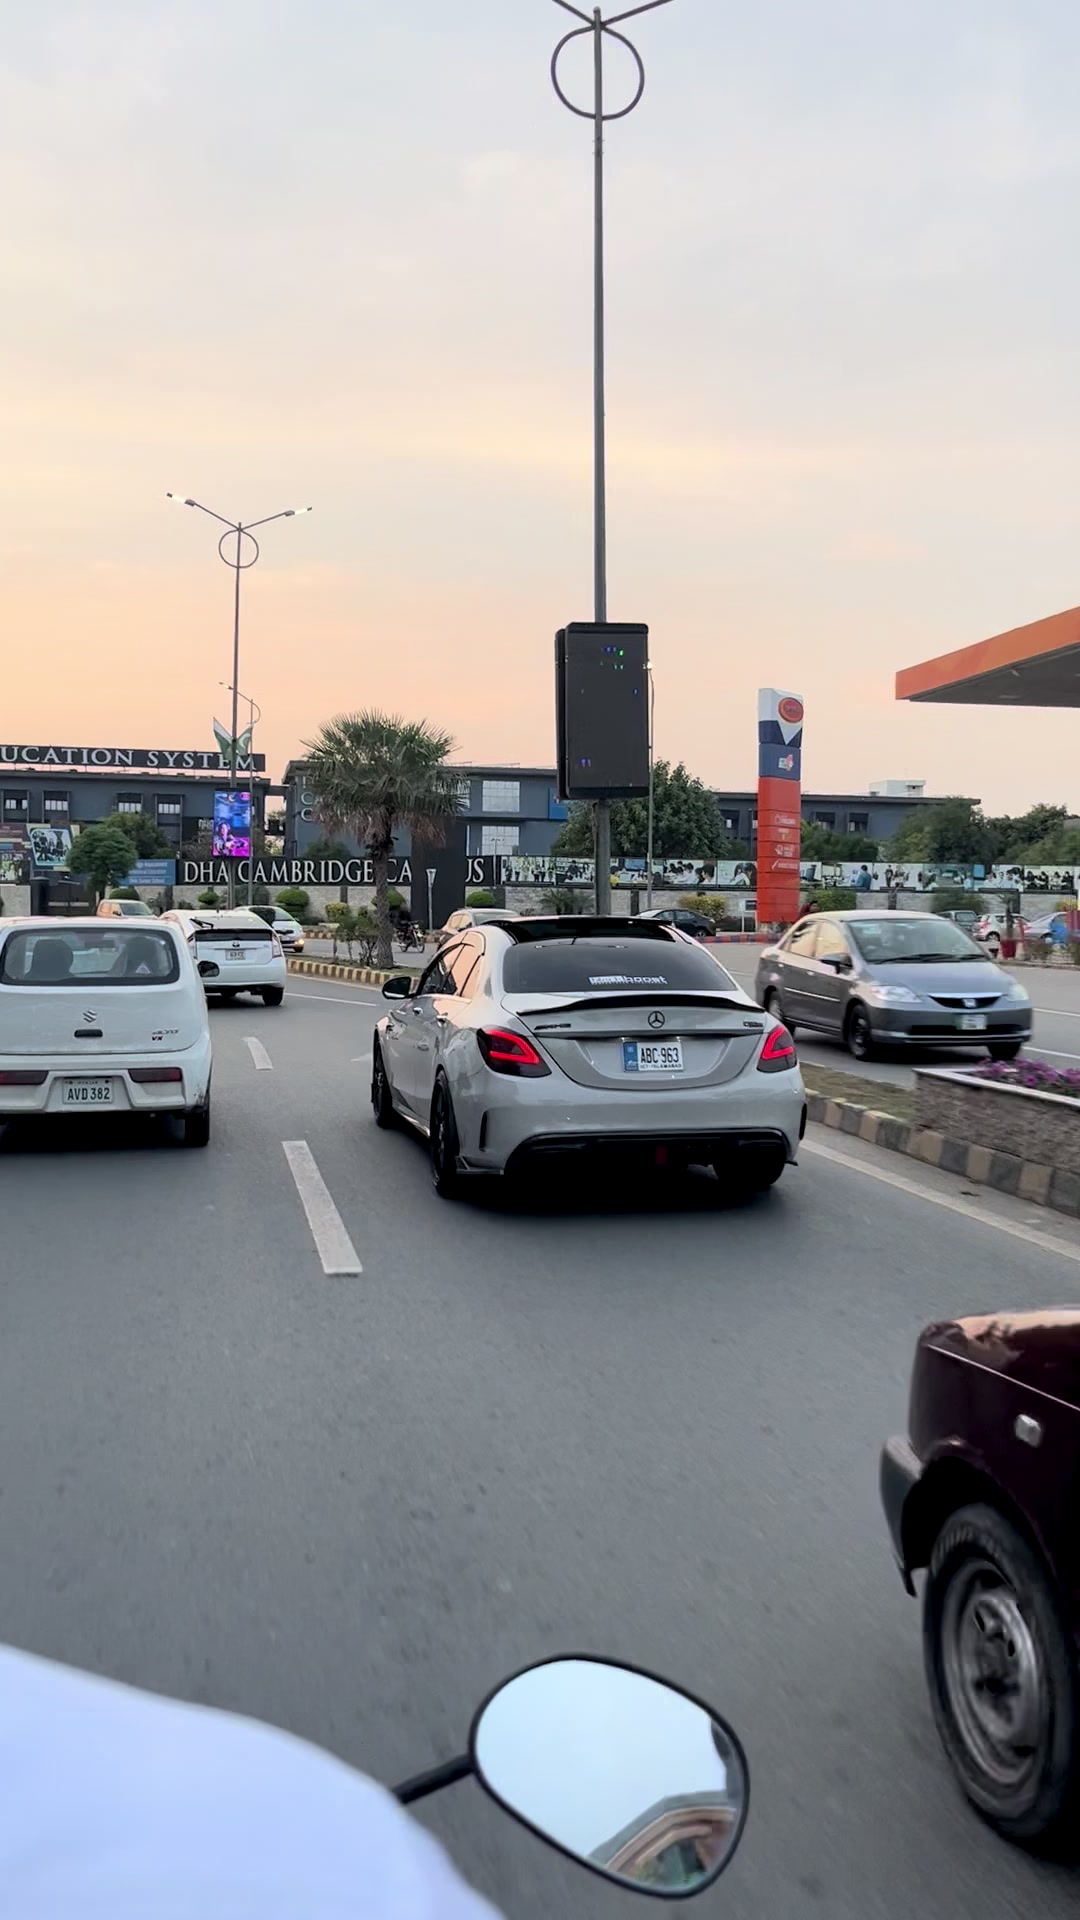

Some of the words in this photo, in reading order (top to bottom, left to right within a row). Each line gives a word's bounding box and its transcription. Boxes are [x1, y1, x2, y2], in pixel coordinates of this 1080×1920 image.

[146, 751, 257, 771] SYSTEM
[184, 861, 229, 883] DHA
[238, 859, 374, 883] CAMBRIDGE
[67, 1088, 88, 1101] AVD
[90, 1087, 110, 1101] 382
